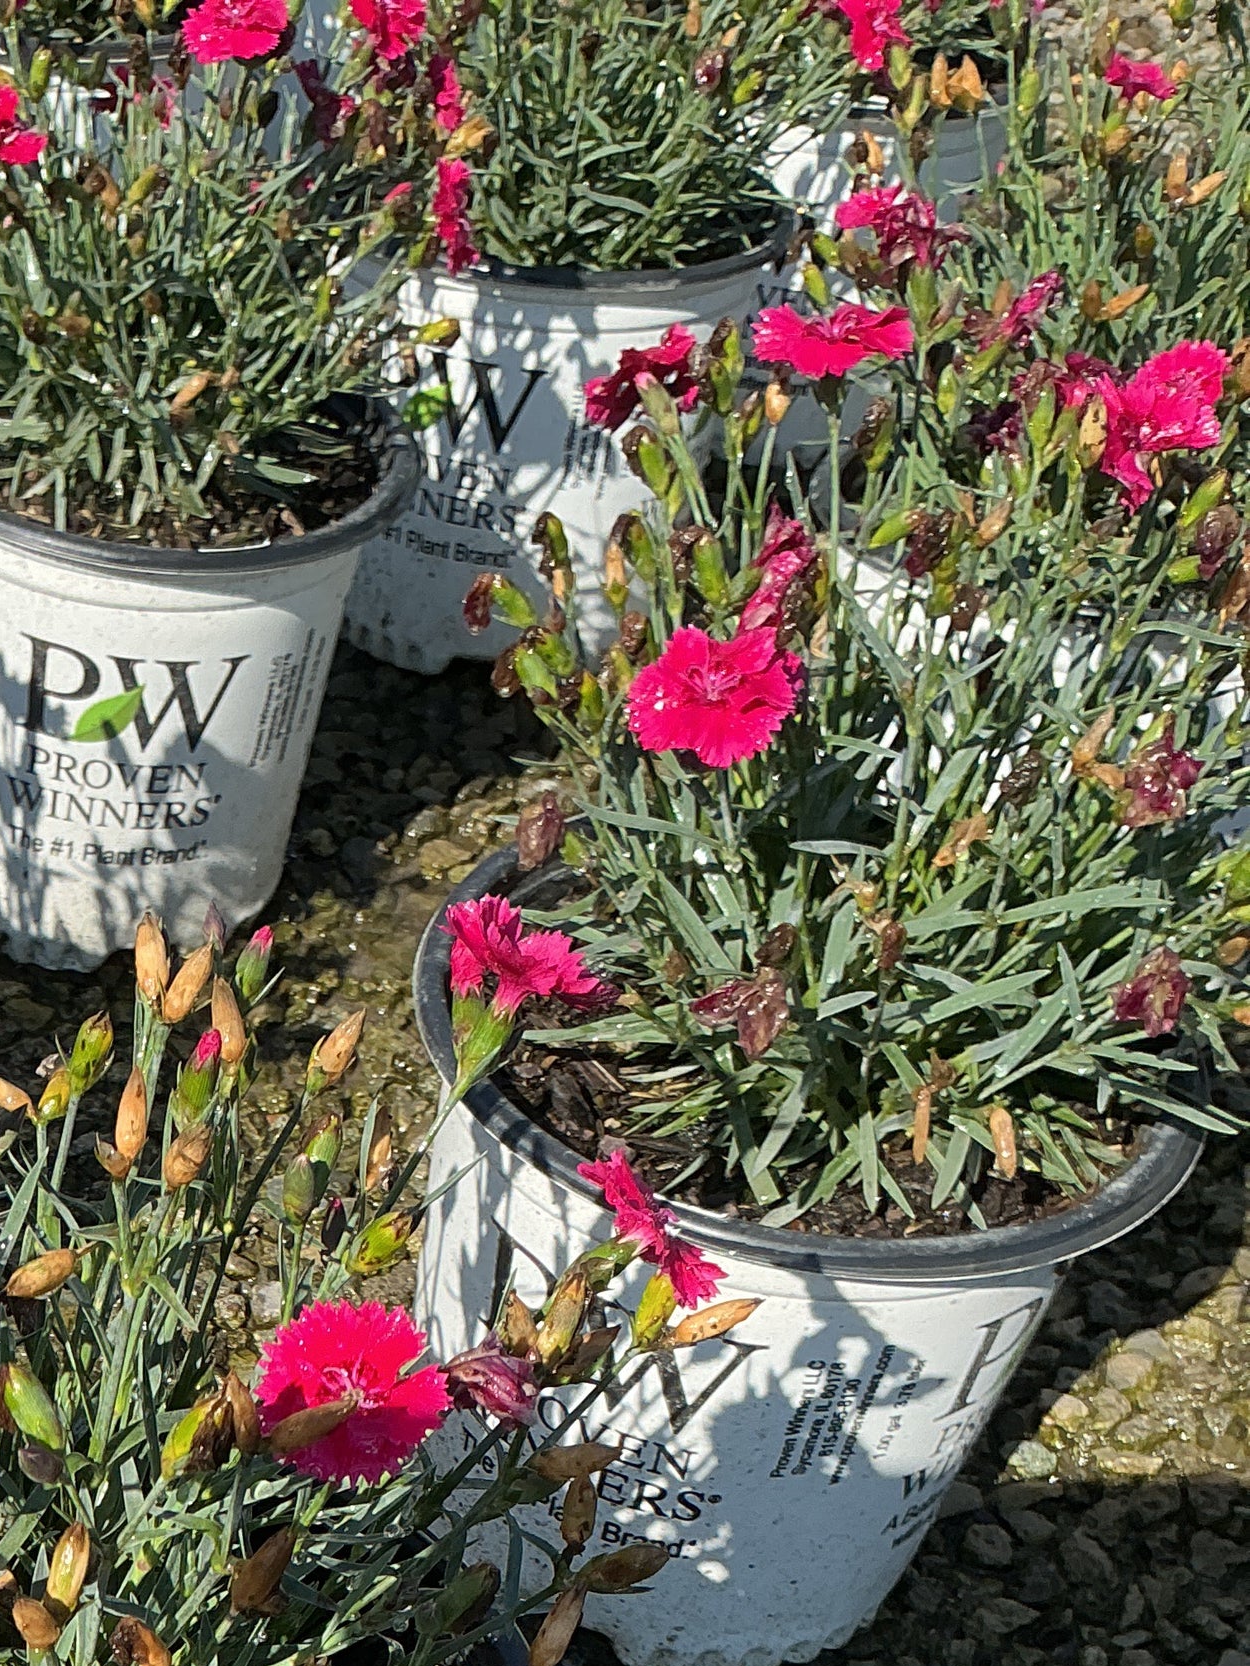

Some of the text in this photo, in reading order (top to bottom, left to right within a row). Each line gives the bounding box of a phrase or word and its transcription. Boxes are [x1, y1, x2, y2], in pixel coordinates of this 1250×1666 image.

[428, 348, 549, 455] W
[14, 631, 251, 752] PW
[26, 744, 207, 794] PROVEN
[9, 824, 44, 851] The
[51, 837, 75, 859] #1
[84, 844, 136, 866] Plant
[770, 1360, 826, 1478] Proven Winners LLC
